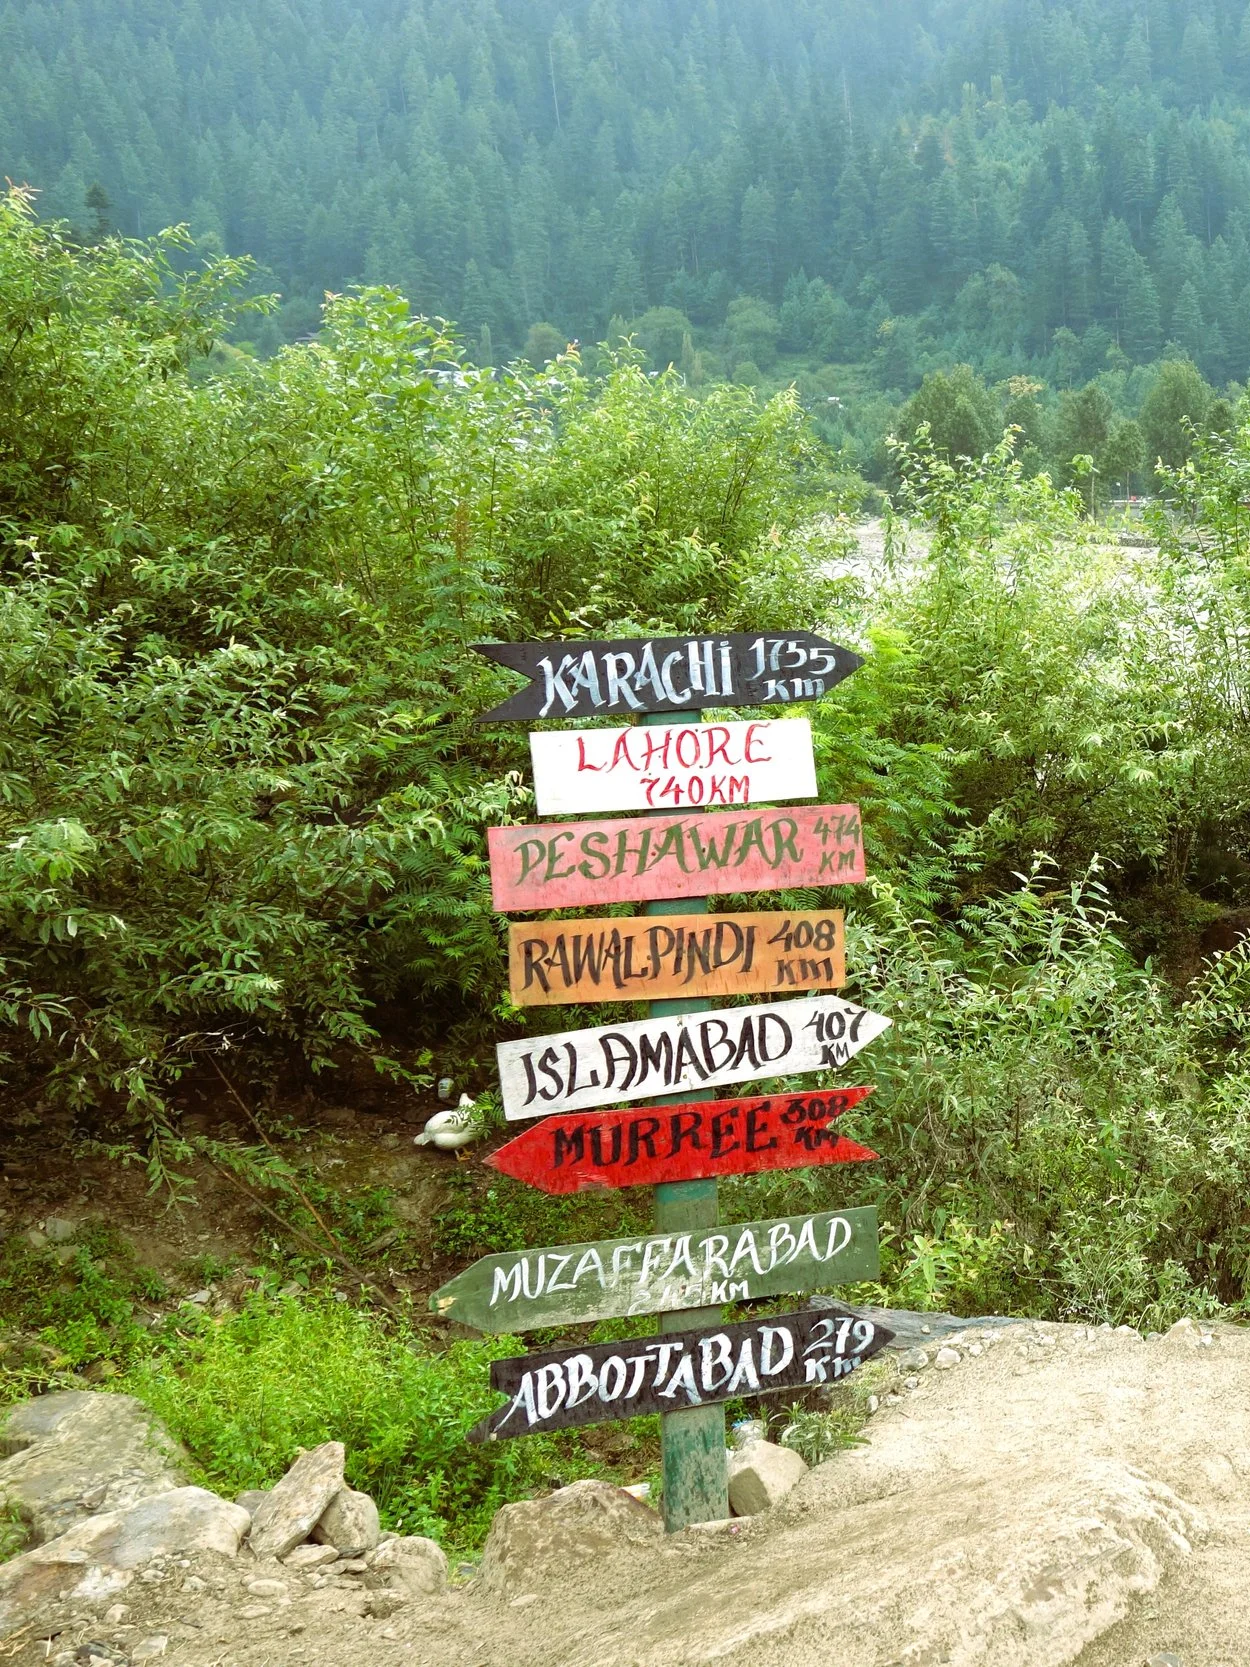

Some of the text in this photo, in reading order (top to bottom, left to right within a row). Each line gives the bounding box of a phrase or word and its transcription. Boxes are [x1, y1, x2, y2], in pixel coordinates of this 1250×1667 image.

[748, 637, 835, 680] 1755
[577, 723, 772, 773] LAHORE
[513, 814, 861, 887] PESHAWAR 474
[818, 849, 856, 874] KM
[520, 918, 836, 993] RAWALPINDI 408
[521, 1009, 867, 1107] ISLAMABAD 407
[820, 1044, 850, 1068] KM
[550, 1101, 778, 1170] MURREE
[489, 1216, 852, 1307] MUZAFFARABAD
[494, 1317, 876, 1432] ABBOTTABAD 279
